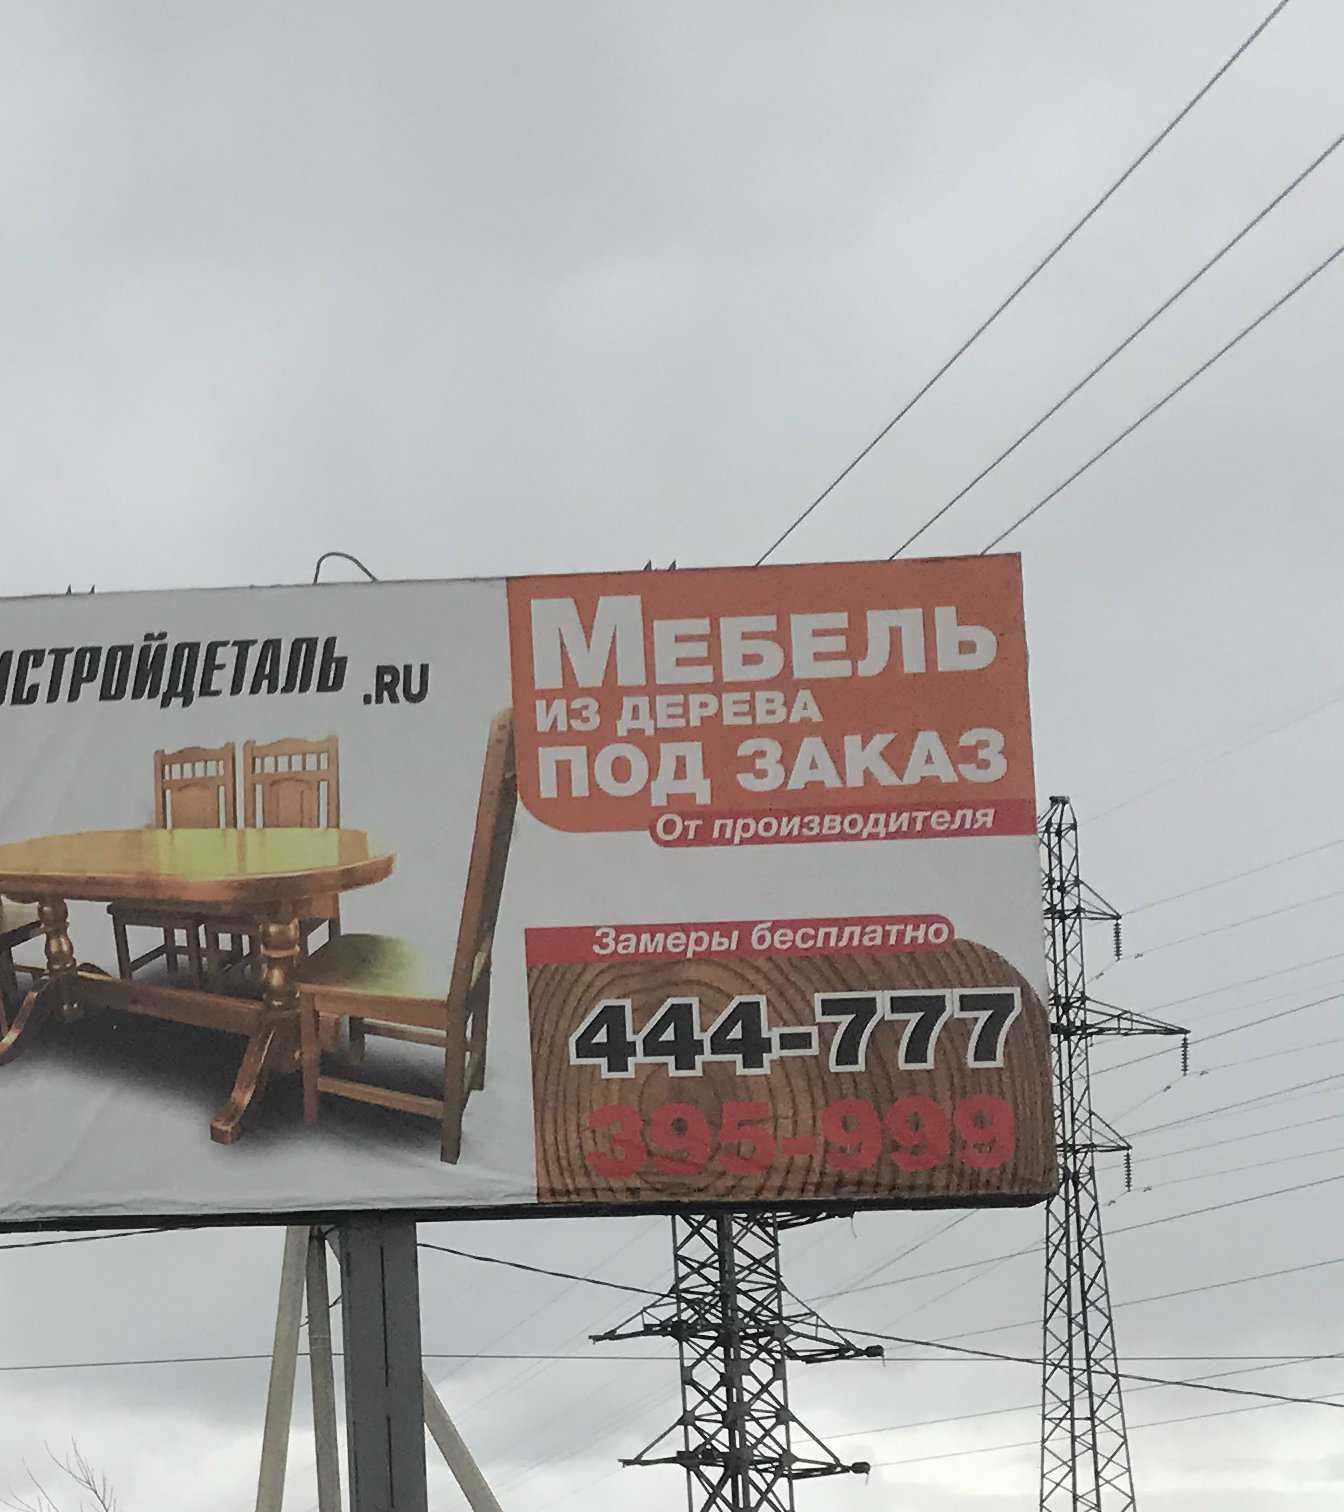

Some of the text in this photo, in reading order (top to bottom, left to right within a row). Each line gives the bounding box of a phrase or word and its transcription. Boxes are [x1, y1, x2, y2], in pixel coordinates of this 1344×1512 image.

[535, 689, 824, 735] ИЗ ДЕРЕВА
[538, 728, 1008, 806] ПОД ЗАКАЗ
[655, 806, 995, 844] От производителя
[592, 920, 950, 959] Замеры бесплатно
[568, 986, 1021, 1079] 444-777
[586, 1095, 1017, 1178] 395-999
